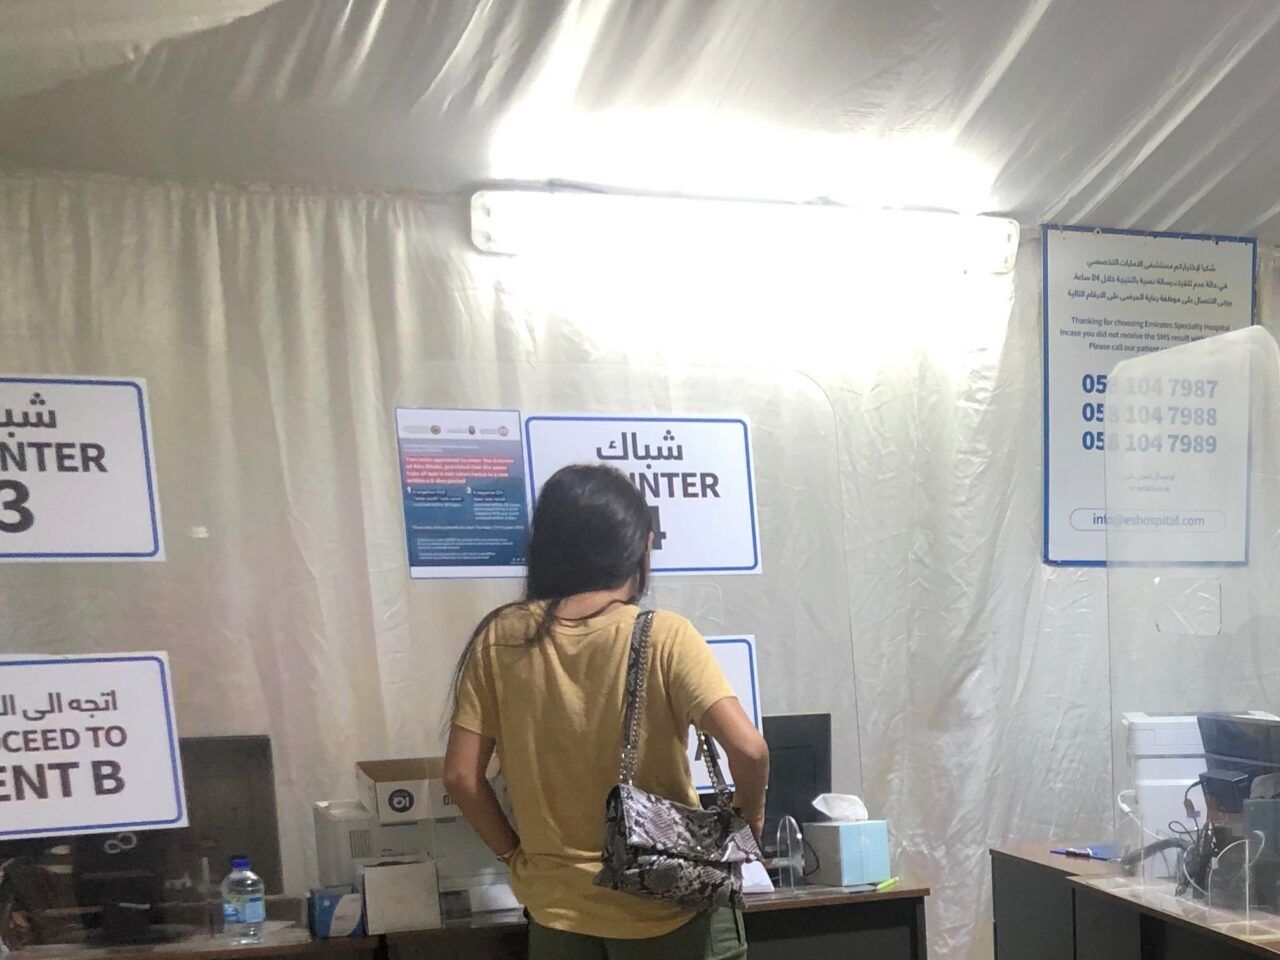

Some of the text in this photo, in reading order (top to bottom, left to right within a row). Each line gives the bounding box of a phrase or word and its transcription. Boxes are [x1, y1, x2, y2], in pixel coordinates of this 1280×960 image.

[1060, 328, 1081, 336] Incase
[1082, 331, 1095, 339] you
[1097, 329, 1107, 338] did
[1120, 332, 1143, 340] receive
[1144, 332, 1155, 340] the
[1156, 332, 1170, 341] SMS
[1171, 333, 1190, 342] result
[1071, 316, 1231, 333] Thanking for choosing Emirates Specialty Hospital
[1089, 342, 1110, 350] Please
[1111, 342, 1123, 351] call
[1136, 345, 1160, 353] patient
[1125, 377, 1163, 396] 104
[1168, 378, 1218, 398] 7987
[1125, 404, 1164, 425] 104
[1168, 405, 1217, 426] 7988
[596, 429, 683, 469] شباك
[1125, 433, 1163, 453] 104
[1168, 434, 1217, 454] 7989
[0, 441, 108, 473] NTER
[630, 472, 720, 498] NTER
[0, 479, 34, 534] 3
[1093, 512, 1205, 528] info@eshospital.com
[22, 692, 63, 722] الى
[68, 689, 118, 719] اتجه
[0, 725, 128, 753] CEED TO
[0, 760, 126, 802] ENT B
